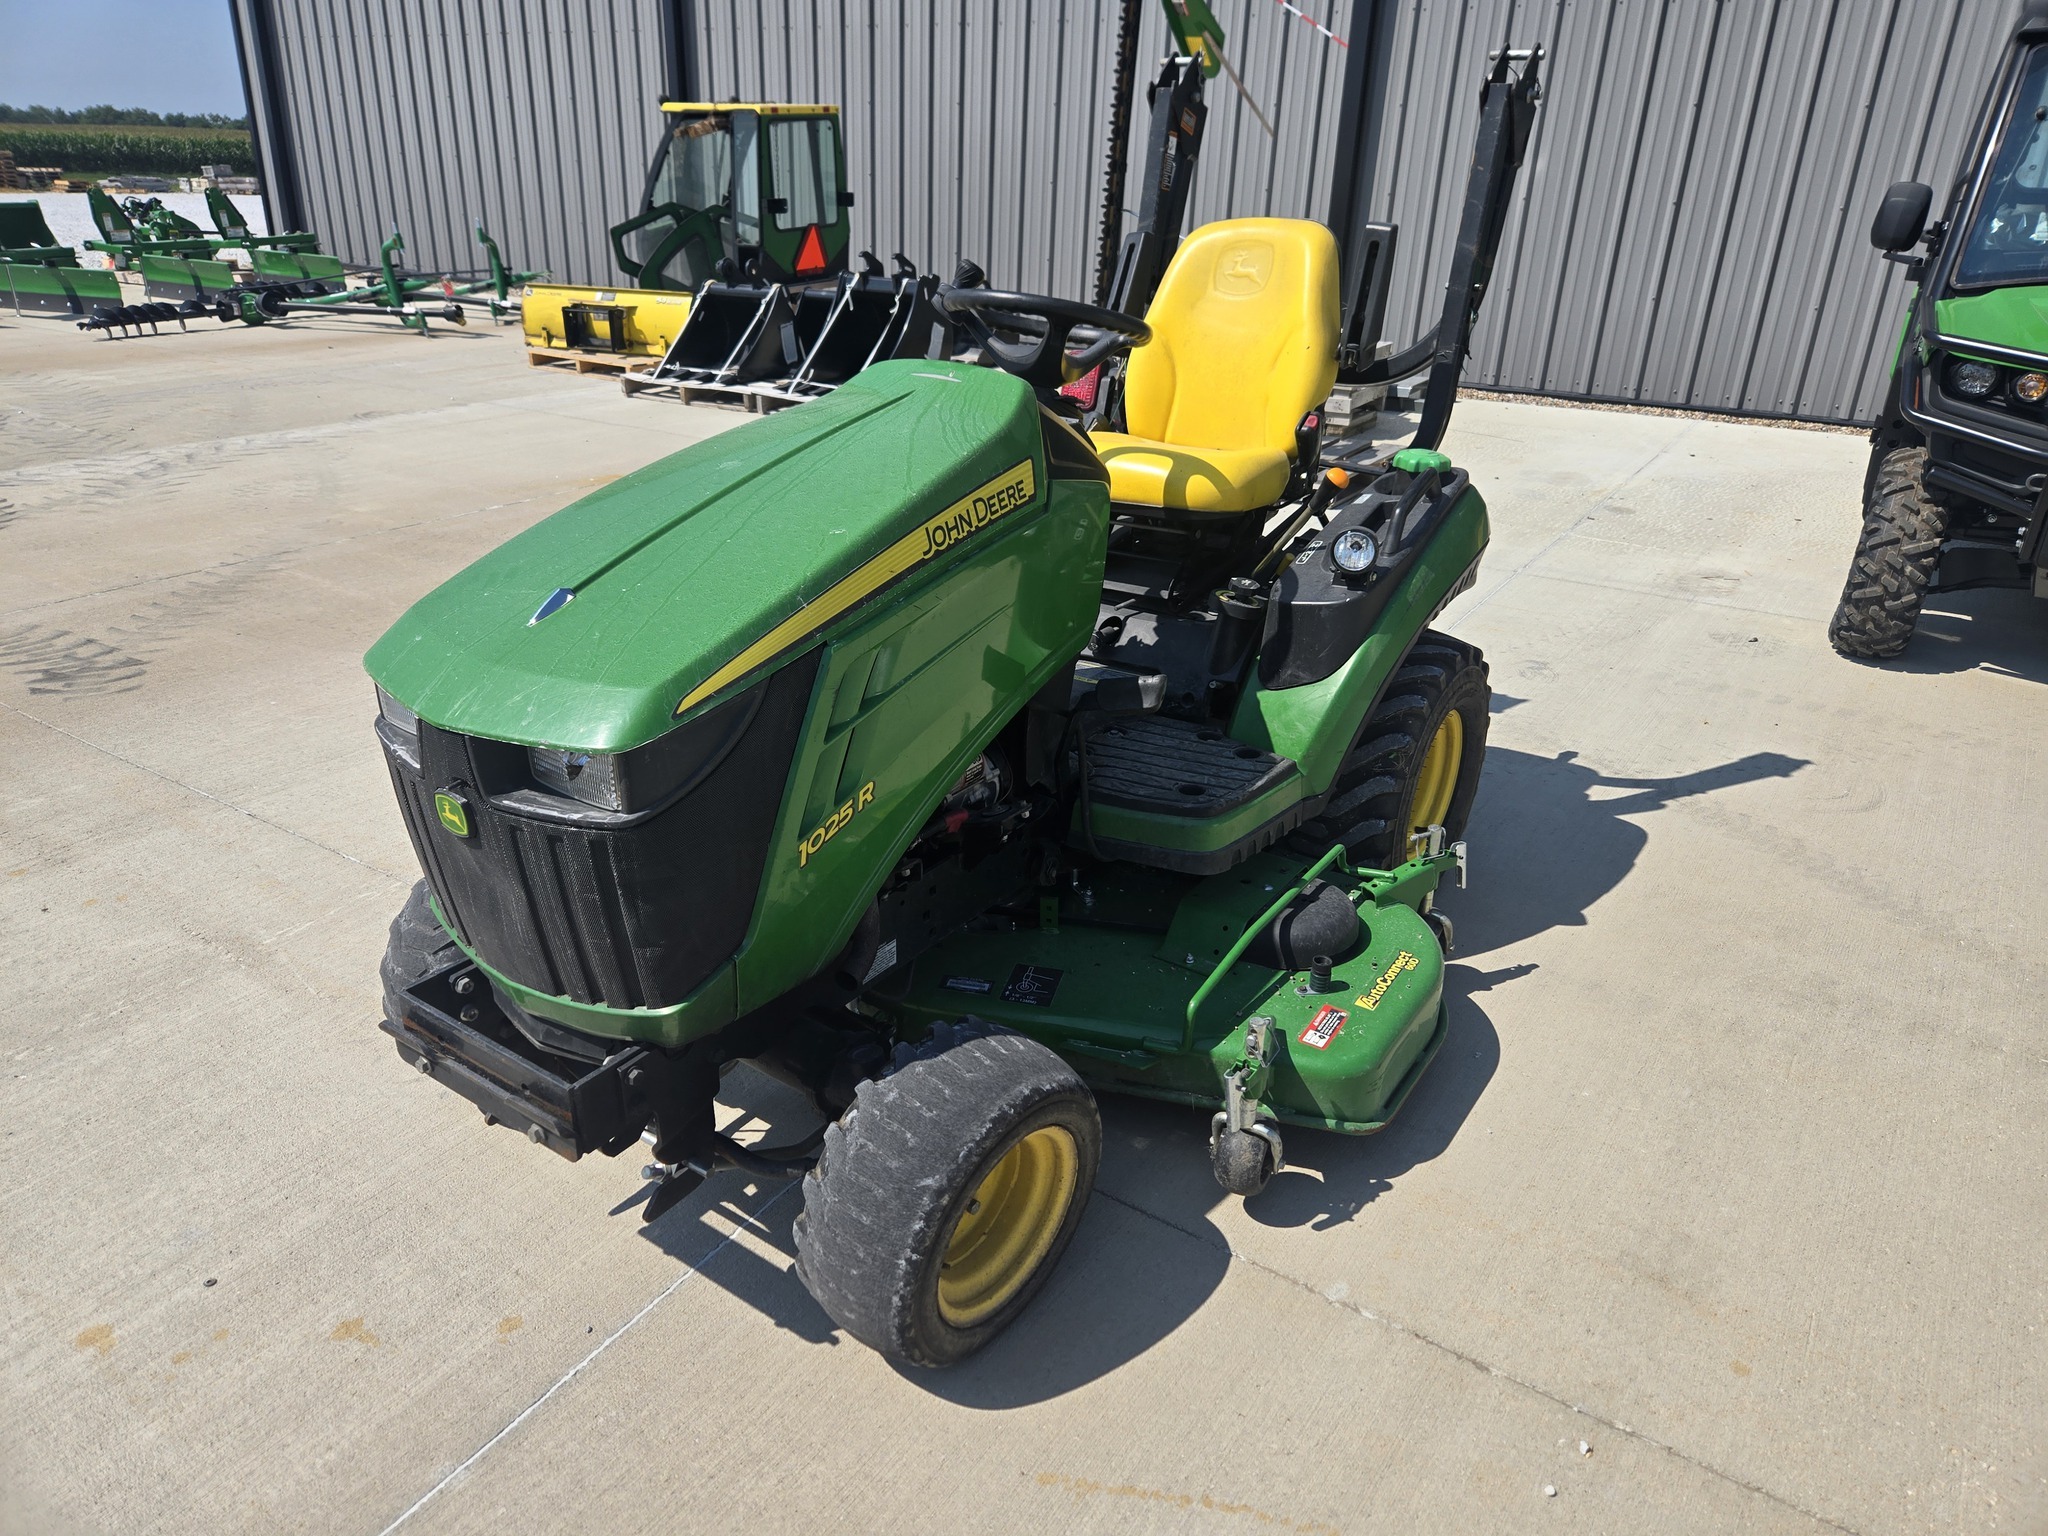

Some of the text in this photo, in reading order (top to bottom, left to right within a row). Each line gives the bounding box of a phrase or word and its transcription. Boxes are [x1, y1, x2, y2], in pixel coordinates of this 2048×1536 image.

[922, 479, 1027, 557] JOHN DEERE
[798, 780, 875, 869] 1025 R
[1359, 950, 1413, 1010] AutoConnect
